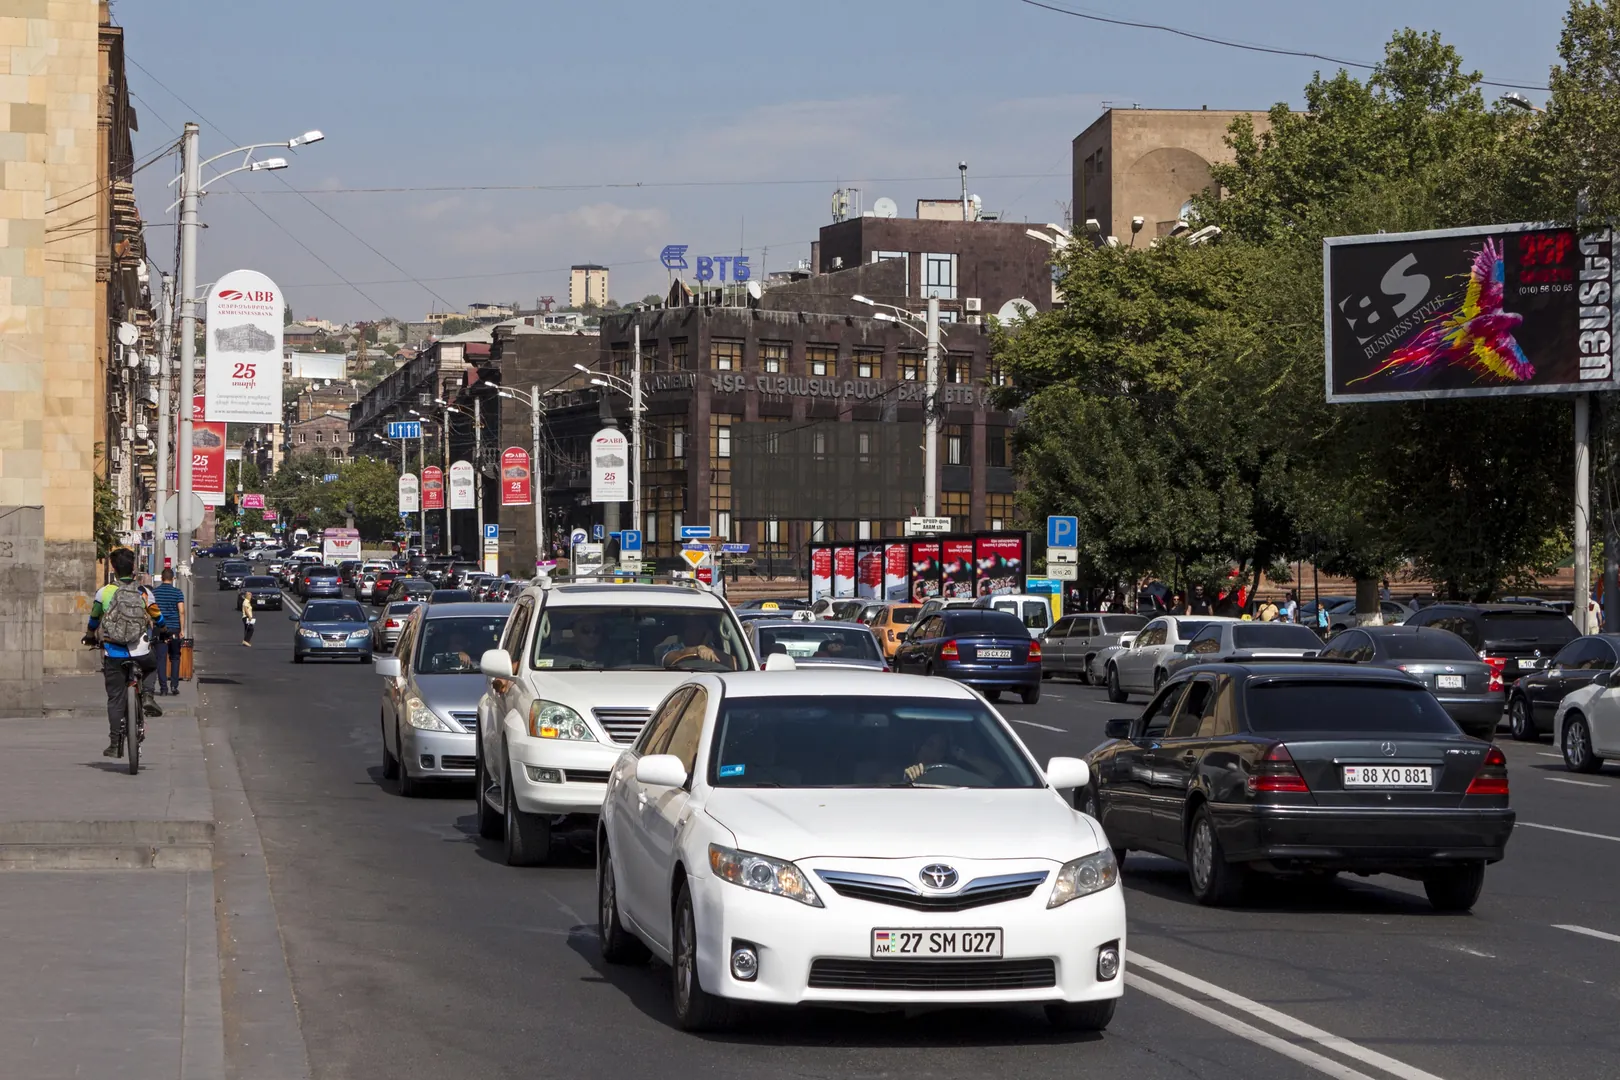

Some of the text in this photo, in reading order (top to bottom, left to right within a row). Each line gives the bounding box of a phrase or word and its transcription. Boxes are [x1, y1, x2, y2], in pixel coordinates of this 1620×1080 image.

[697, 256, 751, 281] ВТБ
[243, 291, 274, 302] ABB
[1519, 286, 1538, 295] (010)
[1540, 285, 1550, 293] 56
[1563, 284, 1573, 292] 65
[1363, 294, 1445, 359] BUSINESS STYLE
[232, 362, 257, 379] 25
[192, 455, 209, 466] 25
[603, 472, 616, 481] 25
[511, 481, 522, 490] 25
[488, 525, 496, 537] P
[1055, 519, 1072, 545] P
[625, 532, 638, 549] P
[1362, 768, 1378, 783] 88
[1382, 768, 1400, 783] XO
[1404, 768, 1428, 783] 881
[876, 932, 996, 953] AM 27 SM 027
